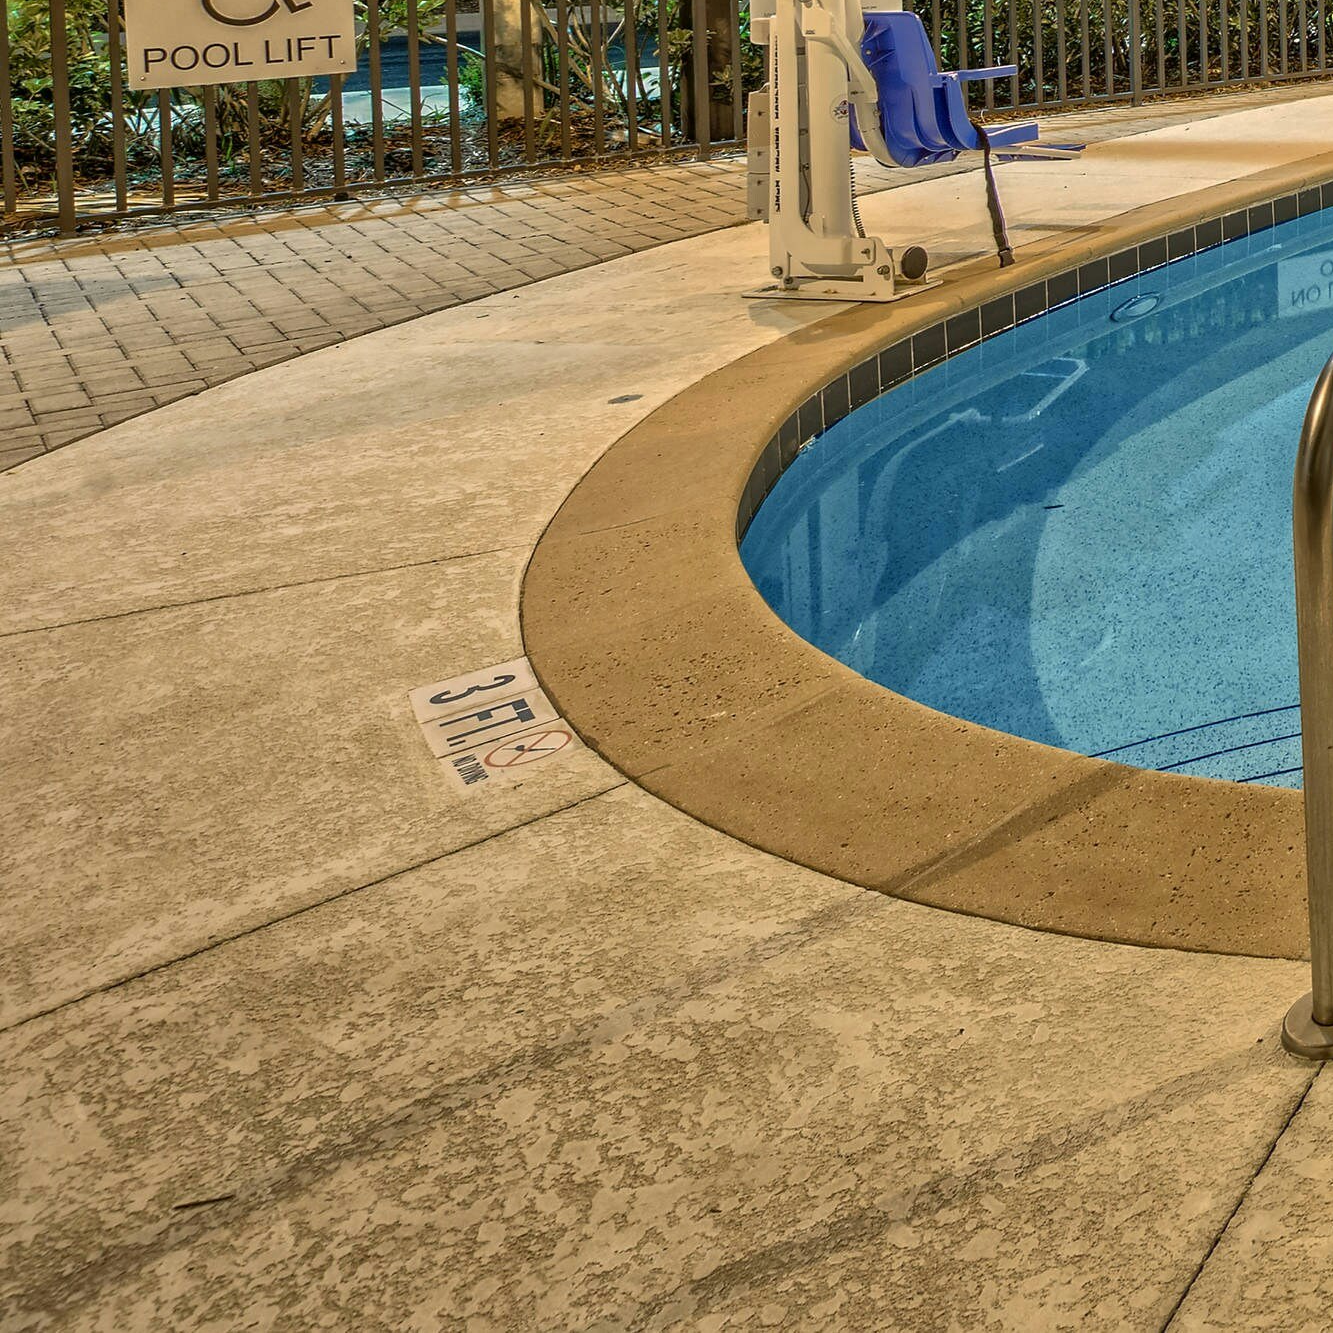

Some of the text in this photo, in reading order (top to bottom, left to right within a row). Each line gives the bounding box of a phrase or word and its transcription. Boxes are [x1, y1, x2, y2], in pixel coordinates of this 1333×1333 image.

[144, 35, 341, 73] POOL LIFT
[429, 674, 516, 704] 3
[452, 752, 489, 785] NO DIVING
